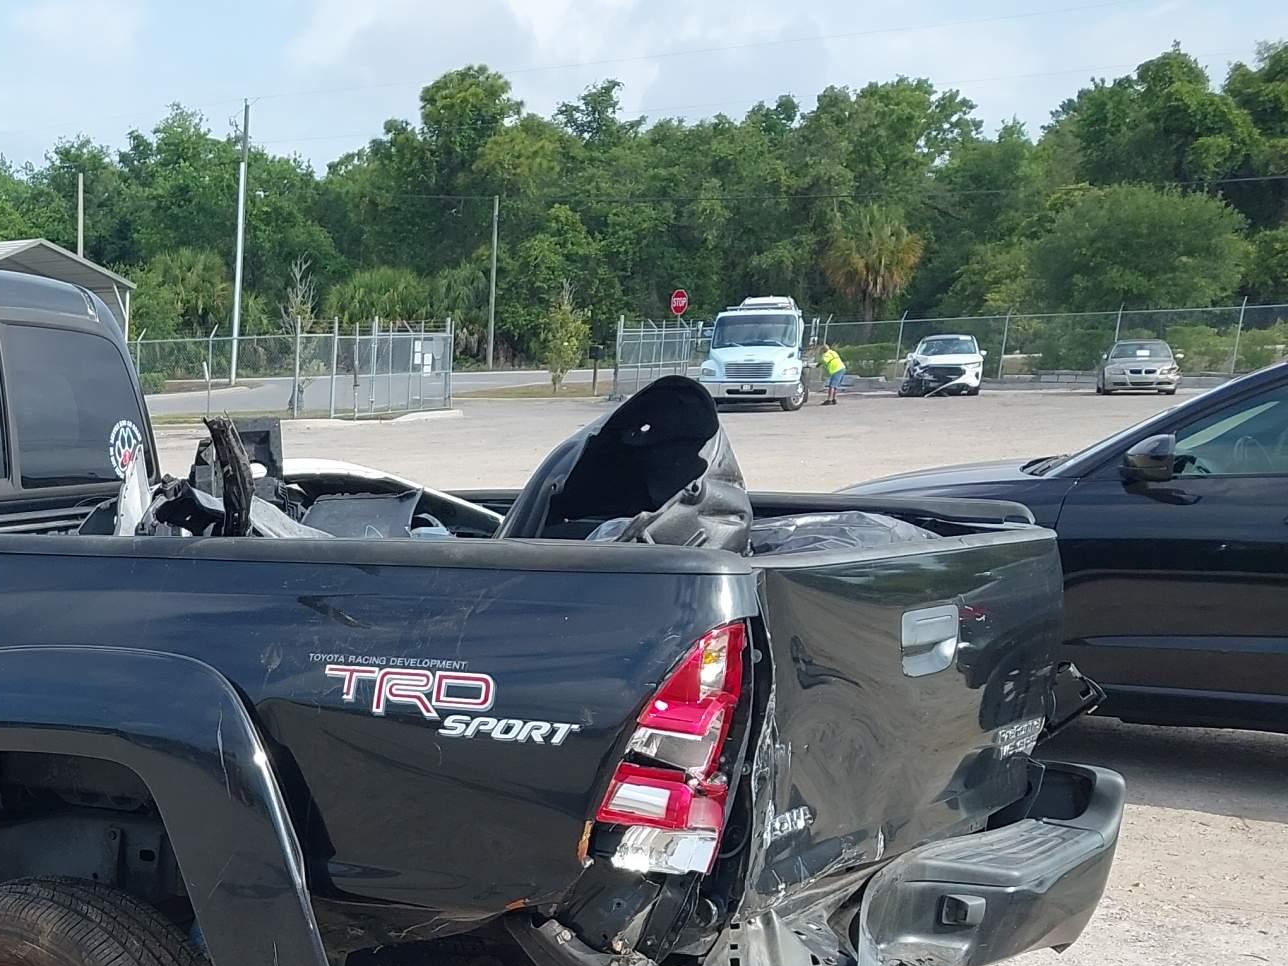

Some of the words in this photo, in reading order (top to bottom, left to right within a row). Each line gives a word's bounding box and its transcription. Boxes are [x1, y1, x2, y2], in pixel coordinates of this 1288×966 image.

[673, 297, 686, 307] STOP
[308, 653, 345, 664] TOYOTA
[348, 655, 387, 666] RACING
[389, 657, 468, 670] DEVELOPMENT
[324, 664, 497, 720] TRD
[437, 714, 581, 747] SPORT
